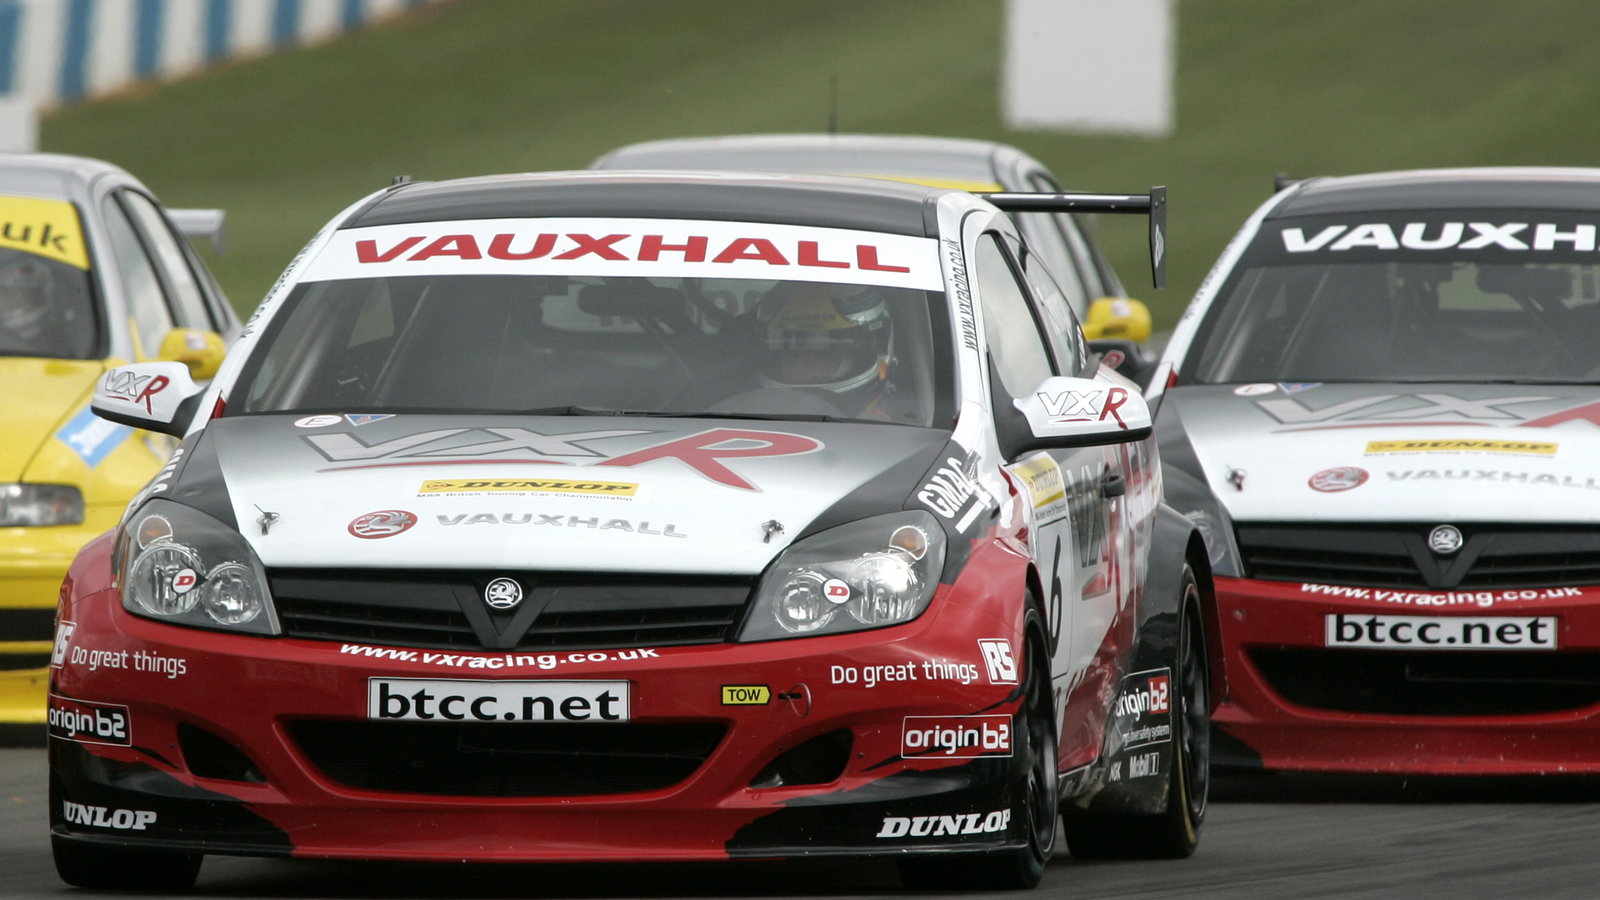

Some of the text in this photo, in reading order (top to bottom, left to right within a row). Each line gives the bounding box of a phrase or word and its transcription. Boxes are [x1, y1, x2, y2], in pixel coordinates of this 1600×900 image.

[1281, 221, 1600, 253] VAUXH
[356, 233, 910, 274] VAUXHALL
[104, 369, 170, 415] VXR
[1037, 387, 1129, 428] VXR
[300, 427, 826, 493] VXR
[458, 481, 634, 491] DUNLOP
[917, 457, 976, 519] GMAC
[436, 513, 688, 539] VAUXHALL
[1301, 583, 1582, 607] www.vxracing.co.uk
[1335, 614, 1548, 643] btcc.net
[71, 646, 187, 679] Do great things
[340, 644, 660, 669] www.vxracing.co.uk
[981, 642, 1017, 681] RS
[831, 659, 978, 688] Do great things
[378, 683, 620, 721] btcc.net
[727, 689, 761, 702] TOW
[49, 706, 93, 737] origin
[905, 723, 1009, 754] origin b2
[63, 801, 157, 831] UNLOP
[876, 808, 1011, 838] DUNLOP
